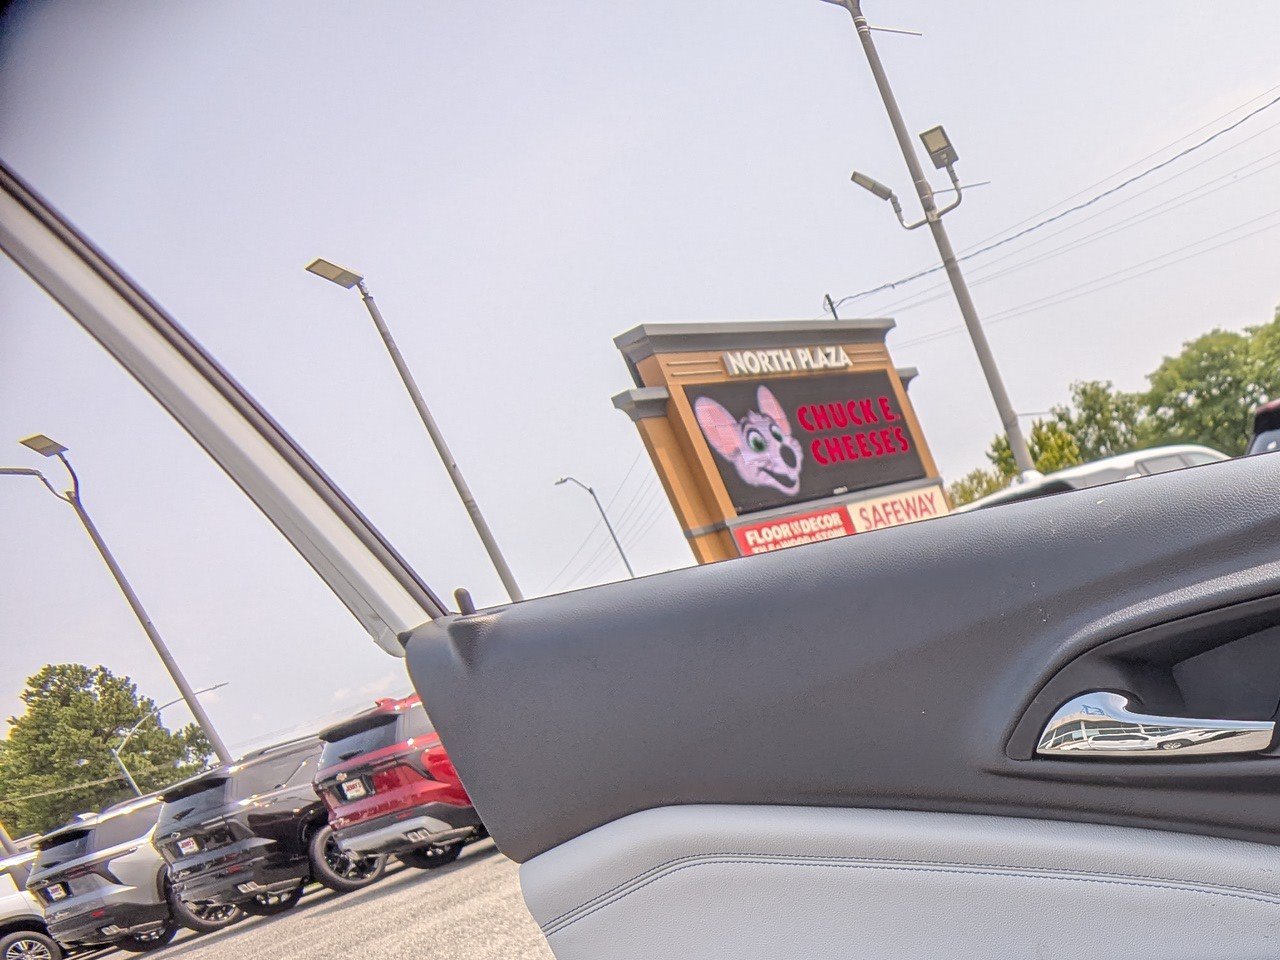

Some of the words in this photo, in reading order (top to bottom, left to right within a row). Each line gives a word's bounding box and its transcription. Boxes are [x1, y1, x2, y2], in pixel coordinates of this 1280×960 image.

[725, 348, 797, 375] NORTH
[796, 345, 853, 370] PLAZA
[797, 398, 878, 432] CHUCK
[811, 426, 909, 466] CHEESE'S
[859, 492, 938, 530] SAFEWAY
[745, 523, 792, 546] FLOOR
[800, 512, 843, 532] DECOR
